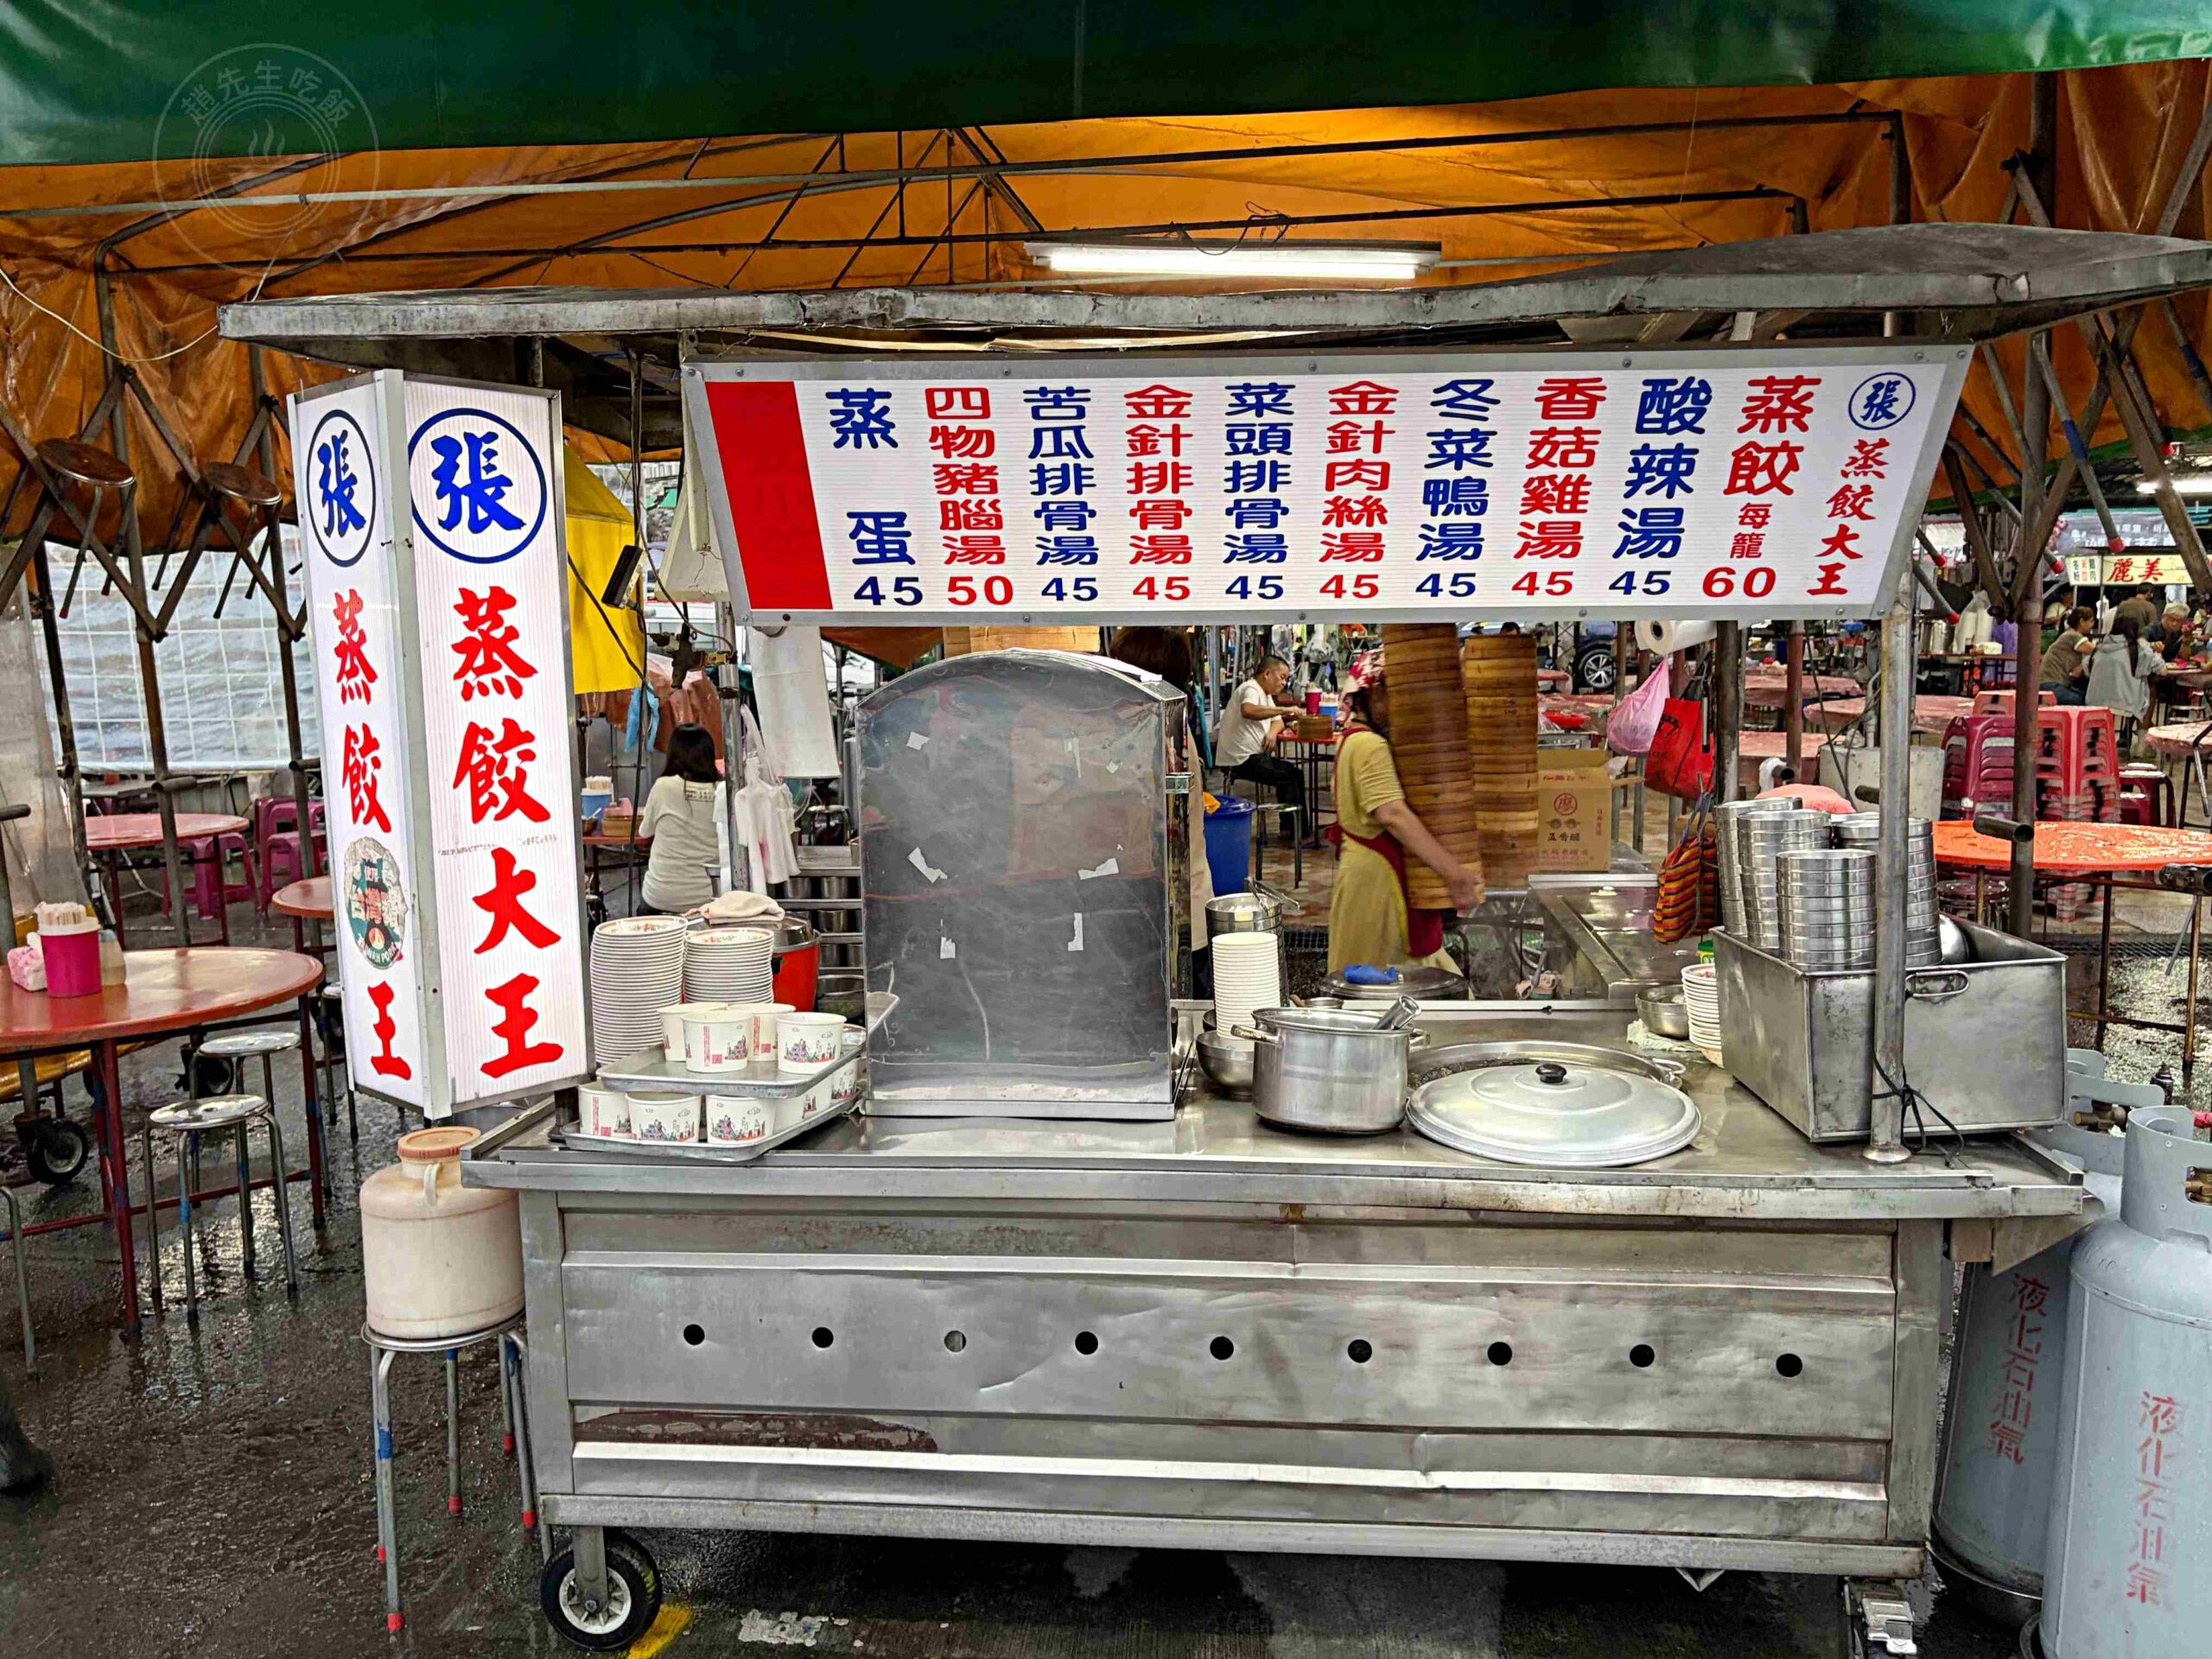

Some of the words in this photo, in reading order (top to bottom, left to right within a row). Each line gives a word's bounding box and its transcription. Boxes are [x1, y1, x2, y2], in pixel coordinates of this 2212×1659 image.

[1724, 375, 1821, 496] 蒸餃
[1859, 379, 1901, 423] 張
[317, 429, 366, 537] 張
[430, 431, 526, 535] 張
[825, 388, 916, 566] 蒸蛋
[925, 387, 1006, 565] 四物豬腦湯
[1022, 386, 1099, 565] 苦瓜排骨湯
[1124, 384, 1194, 565] 金針排骨湯
[1223, 382, 1296, 564] 菜頭排骨湯
[1319, 380, 1399, 563] 金針肉絲湯
[1414, 378, 1502, 562] 冬菜鴨湯
[1514, 377, 1607, 560] 香菇雞湯
[1611, 377, 1713, 559] 酸辣湯
[1807, 437, 1891, 596] 蒸餃大王
[1511, 570, 1574, 597] 45
[1609, 570, 1671, 595] 45
[1701, 567, 1777, 598] 60
[1729, 502, 1771, 559] 每籠
[854, 576, 923, 605] 45
[947, 575, 1014, 606] 50
[1040, 576, 1098, 601] 45
[1132, 576, 1191, 601] 45
[1225, 575, 1284, 600] 45
[1319, 574, 1380, 599] 45
[1415, 573, 1477, 598] 45
[451, 586, 565, 1079] 蒸餃大王
